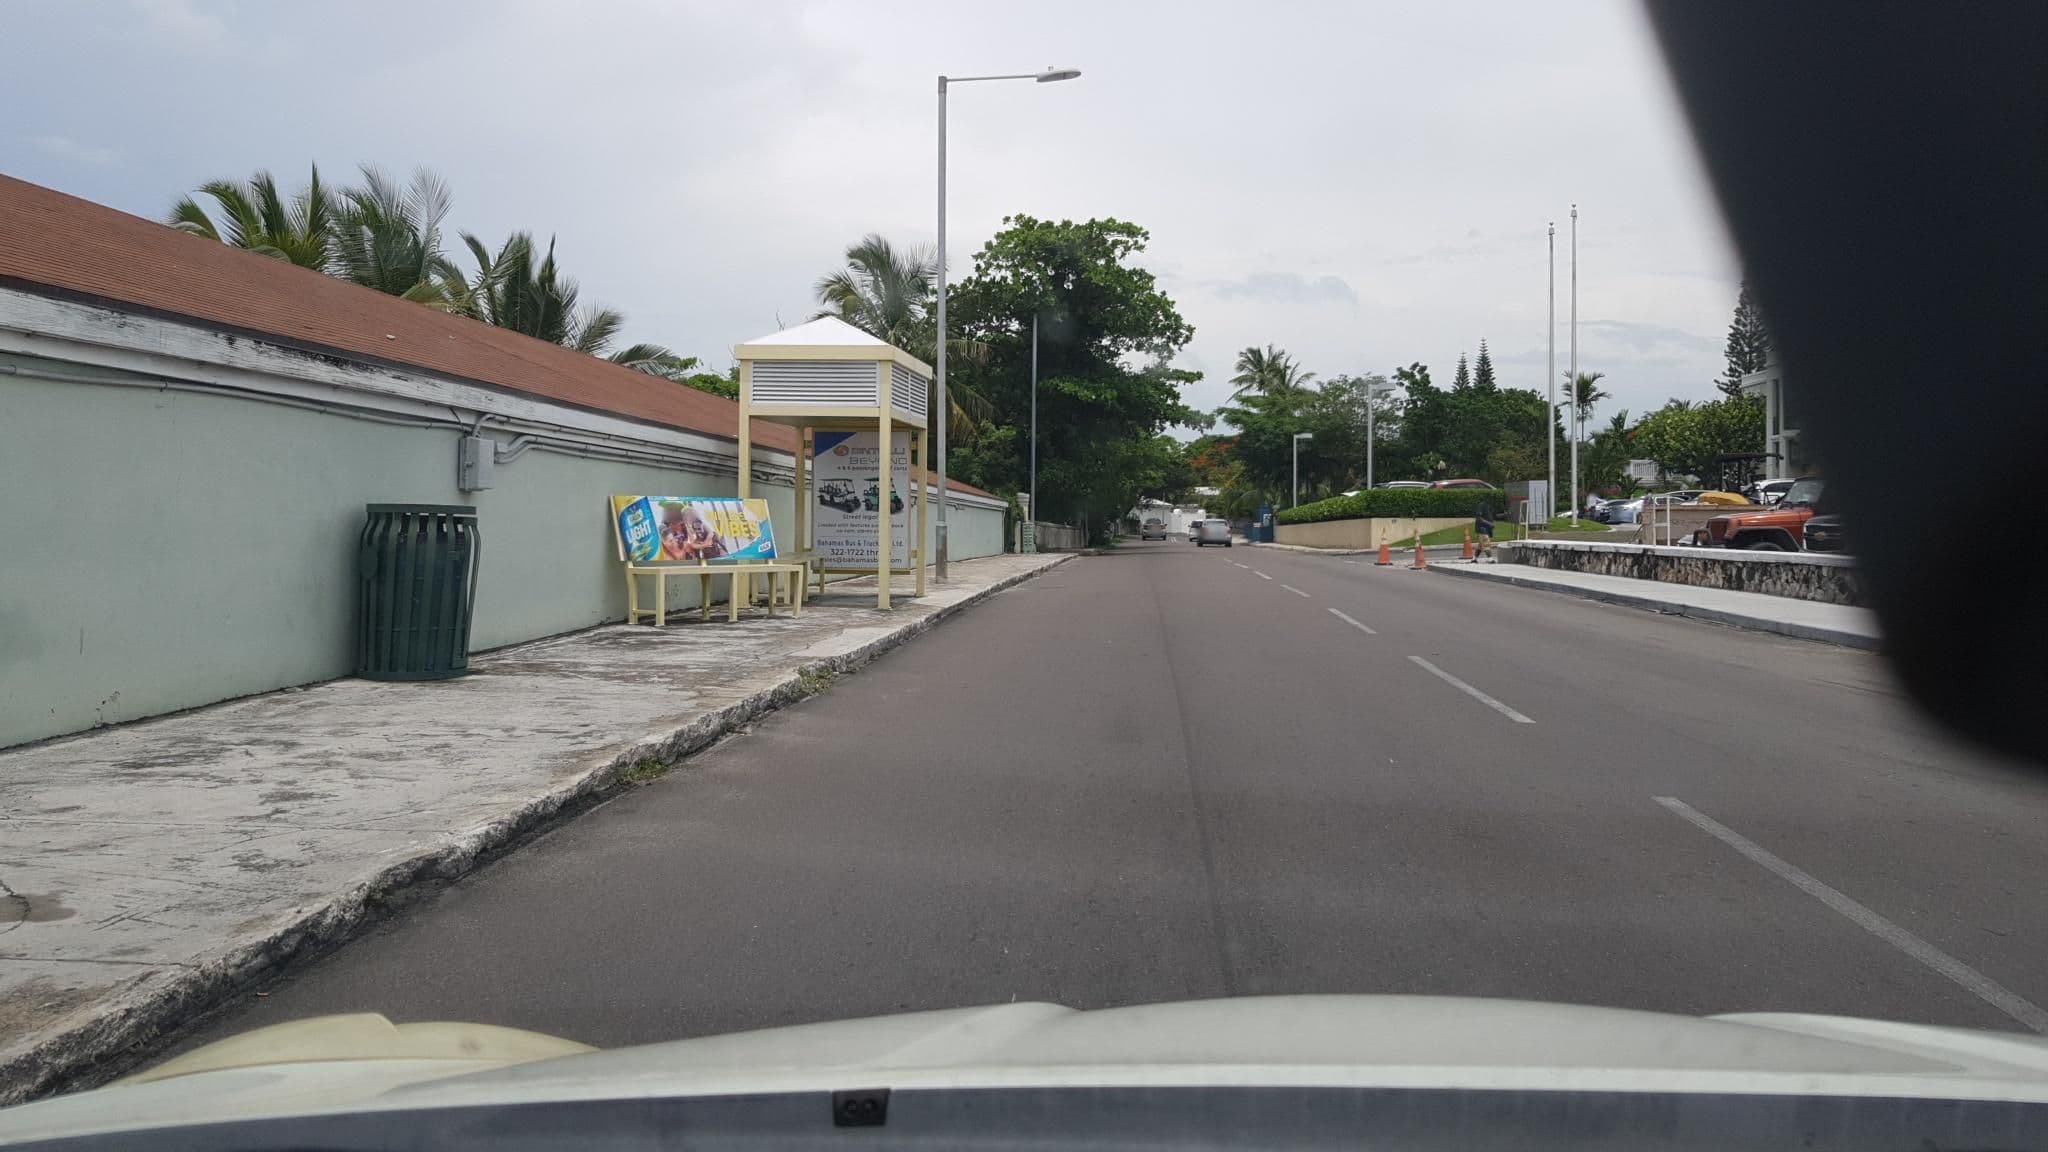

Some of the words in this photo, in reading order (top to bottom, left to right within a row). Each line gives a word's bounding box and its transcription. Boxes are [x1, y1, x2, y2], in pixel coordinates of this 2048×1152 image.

[849, 456, 908, 465] BEYND
[714, 519, 761, 538] VIBES
[830, 548, 865, 556] 322-1722
